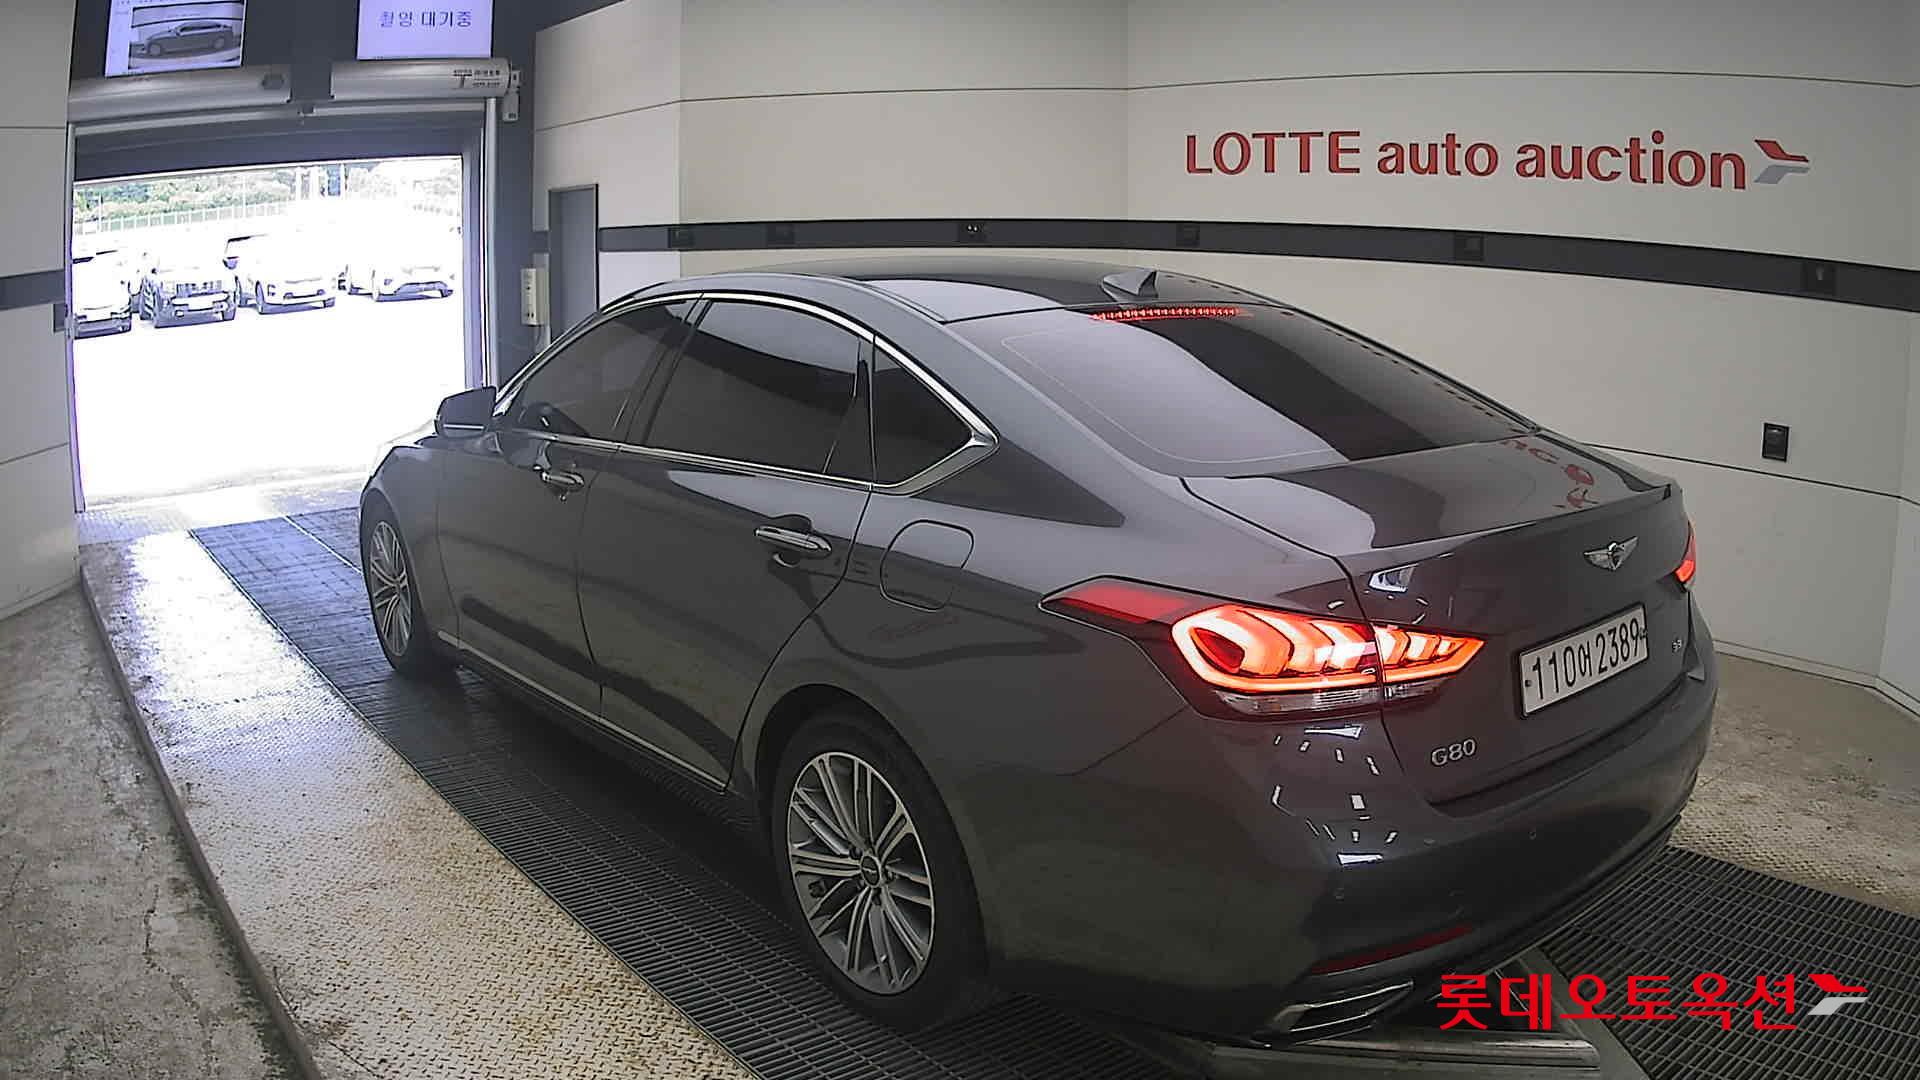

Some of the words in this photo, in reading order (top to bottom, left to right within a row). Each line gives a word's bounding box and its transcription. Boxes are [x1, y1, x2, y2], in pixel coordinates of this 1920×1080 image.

[421, 10, 472, 28] 대기중
[1185, 130, 1361, 175] LOTTE
[1377, 133, 1498, 177] auto
[1516, 130, 1746, 189] auction
[1431, 738, 1476, 766] G80
